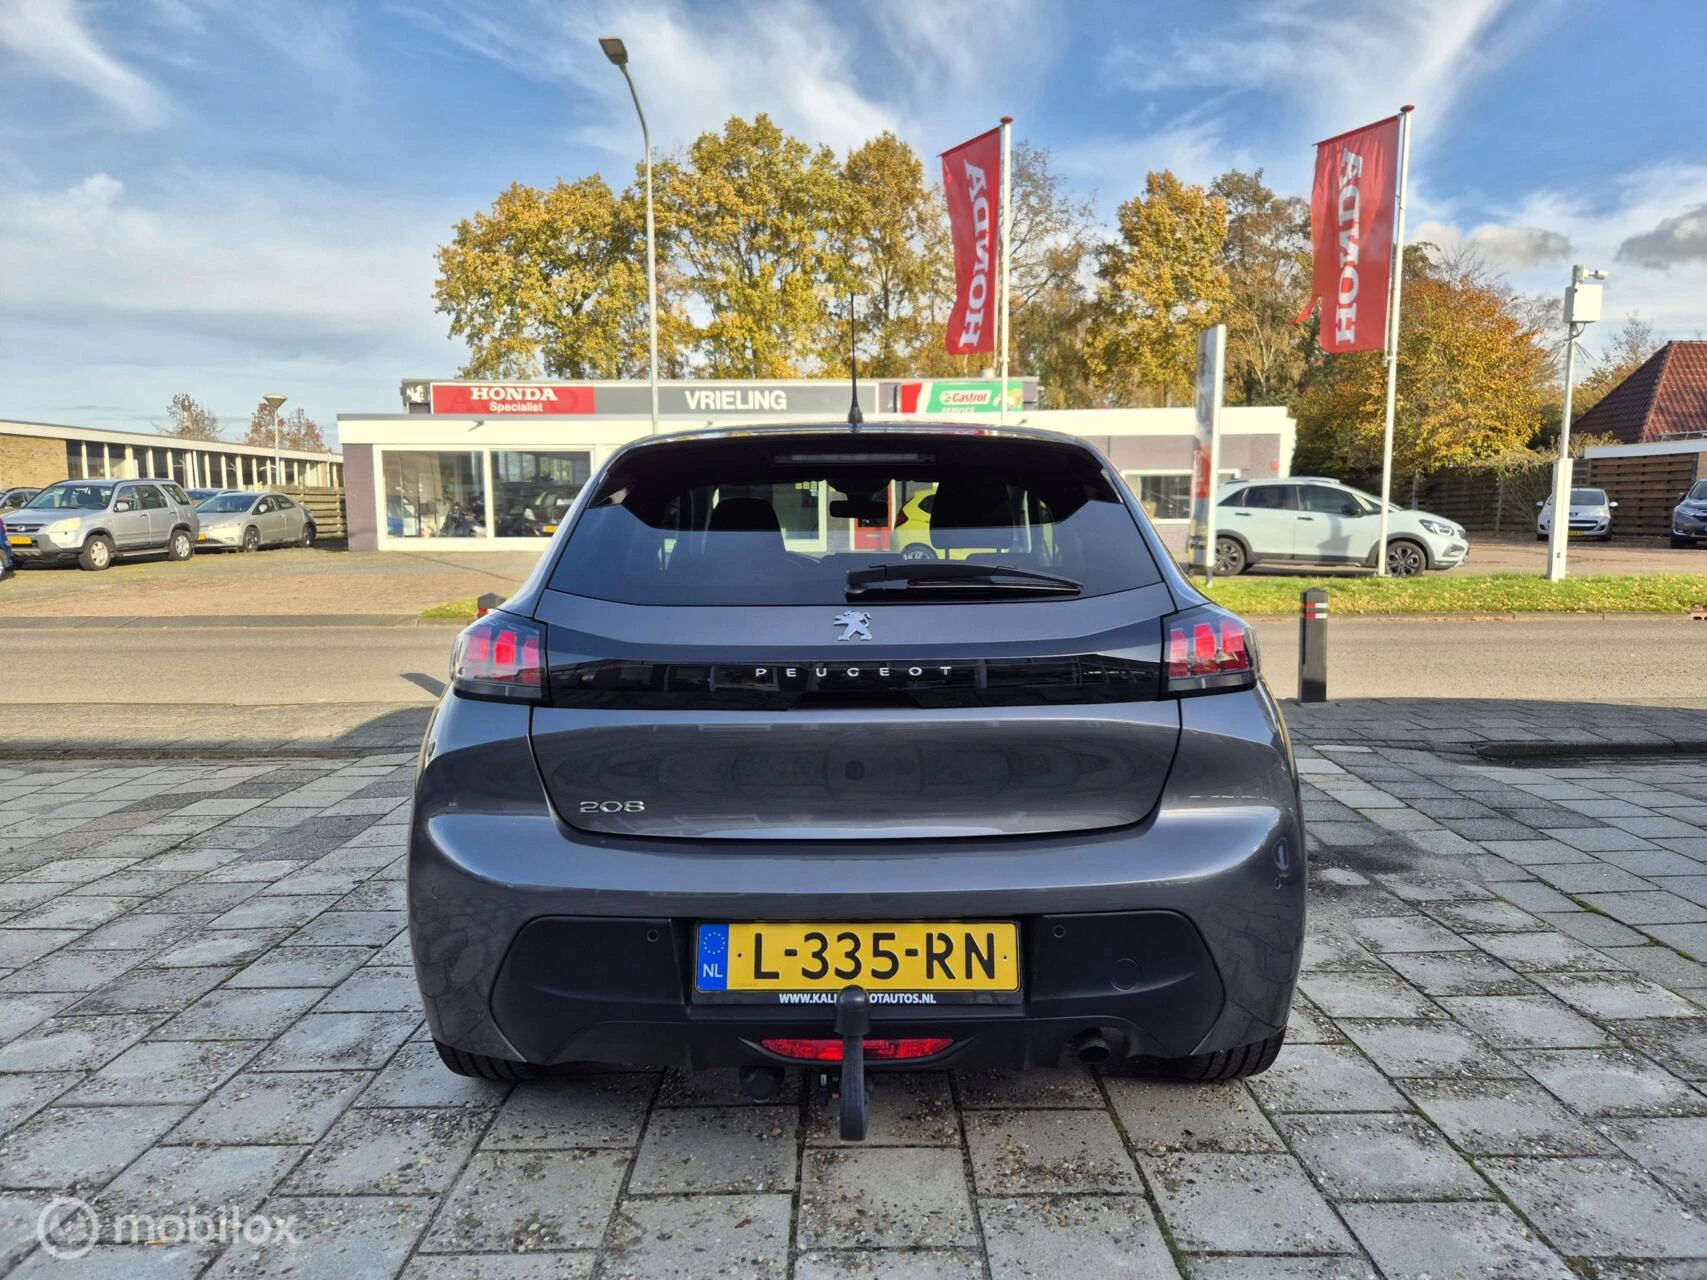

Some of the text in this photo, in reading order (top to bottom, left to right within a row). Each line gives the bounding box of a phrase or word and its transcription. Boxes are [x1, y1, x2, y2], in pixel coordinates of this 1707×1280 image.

[471, 387, 558, 401] HONDA
[685, 389, 787, 411] VRIELING
[952, 392, 987, 403] Castrol
[489, 402, 543, 413] Specialist
[755, 666, 952, 678] PEUGEOT
[579, 801, 646, 813] 208
[754, 932, 995, 980] L-335-RN
[702, 963, 724, 979] NL
[778, 993, 937, 1004] WWW.KALOTAUTOS.NL
